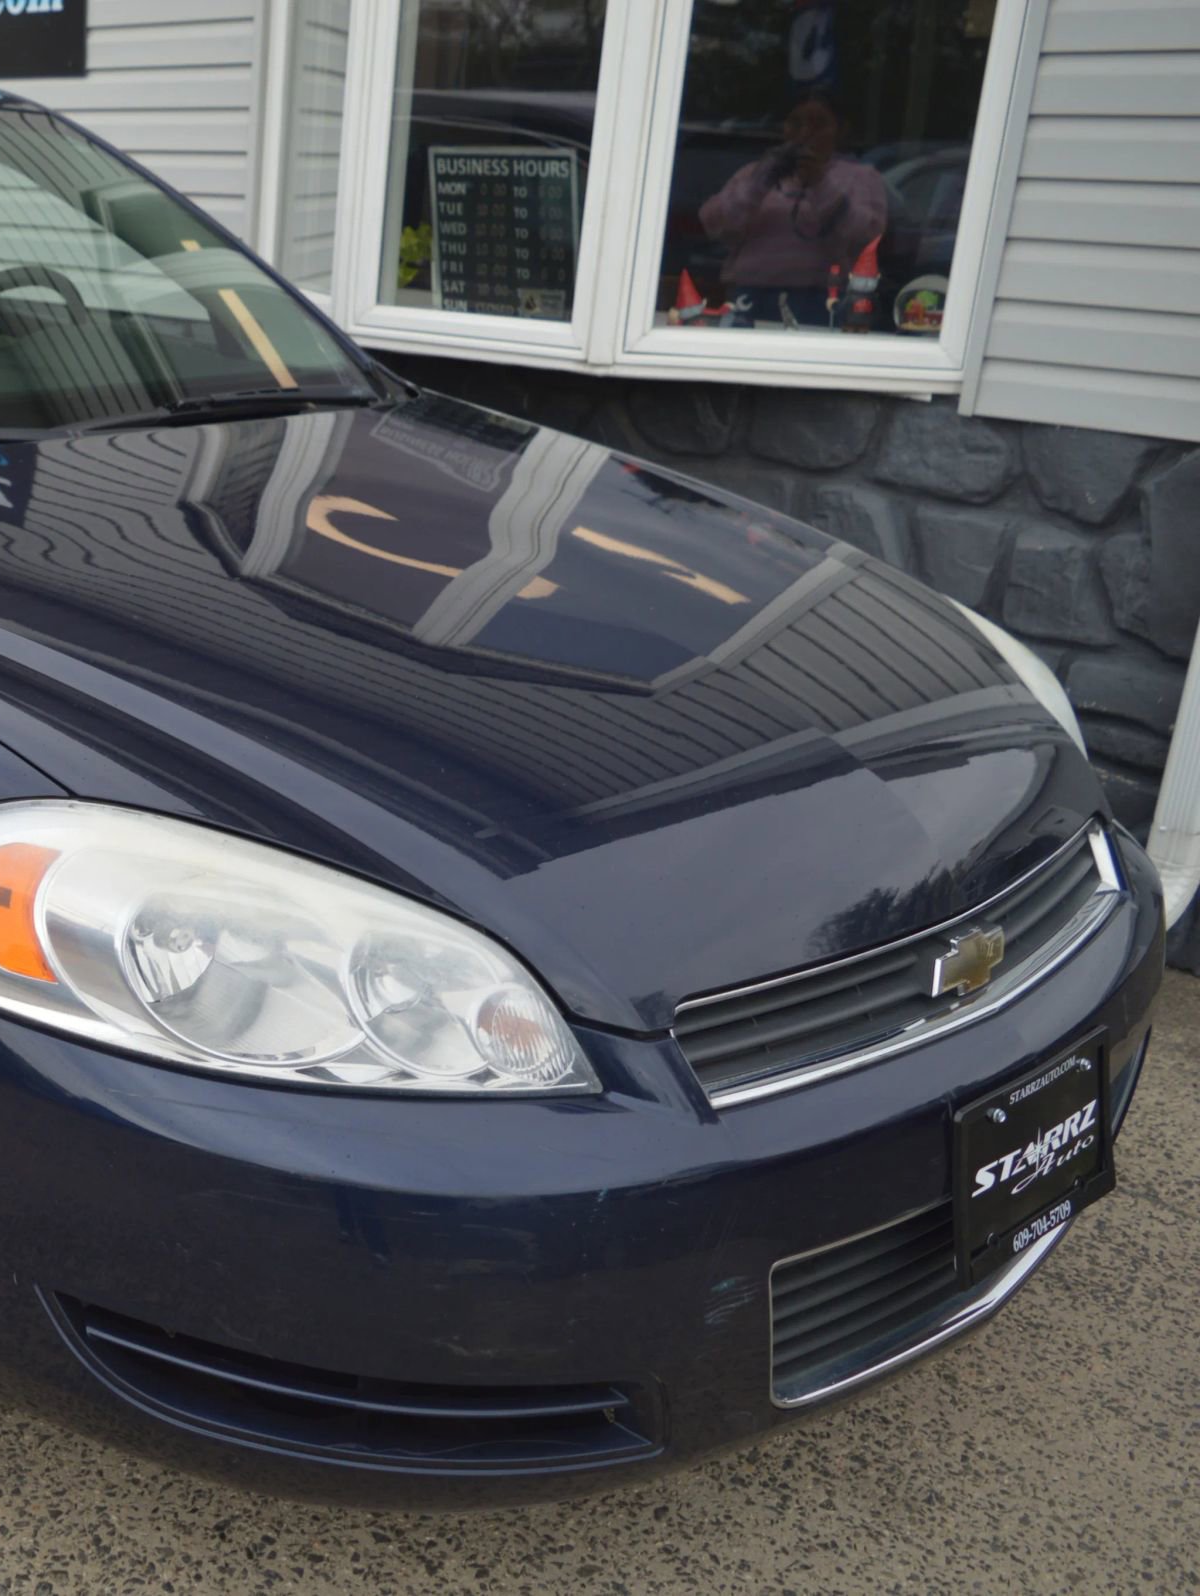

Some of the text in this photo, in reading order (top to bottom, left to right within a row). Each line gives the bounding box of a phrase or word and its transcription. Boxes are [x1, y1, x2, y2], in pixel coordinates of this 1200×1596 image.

[436, 157, 570, 178] BUSINESS HOURS
[437, 181, 467, 195] MON
[513, 186, 528, 198] TO
[438, 202, 464, 216] TUE
[513, 207, 528, 219] TO
[439, 222, 467, 235] WED
[514, 227, 529, 239] TO
[440, 242, 467, 255] THU
[515, 248, 529, 260] TO
[442, 261, 464, 274] FRI
[516, 267, 530, 279] TO
[442, 280, 466, 293] SAT
[1009, 1055, 1076, 1105] STARRZAUTO.COM
[971, 1099, 1097, 1198] STARRZ
[1011, 1134, 1094, 1195] Auto
[1012, 1200, 1072, 1252] 609-704-5709
